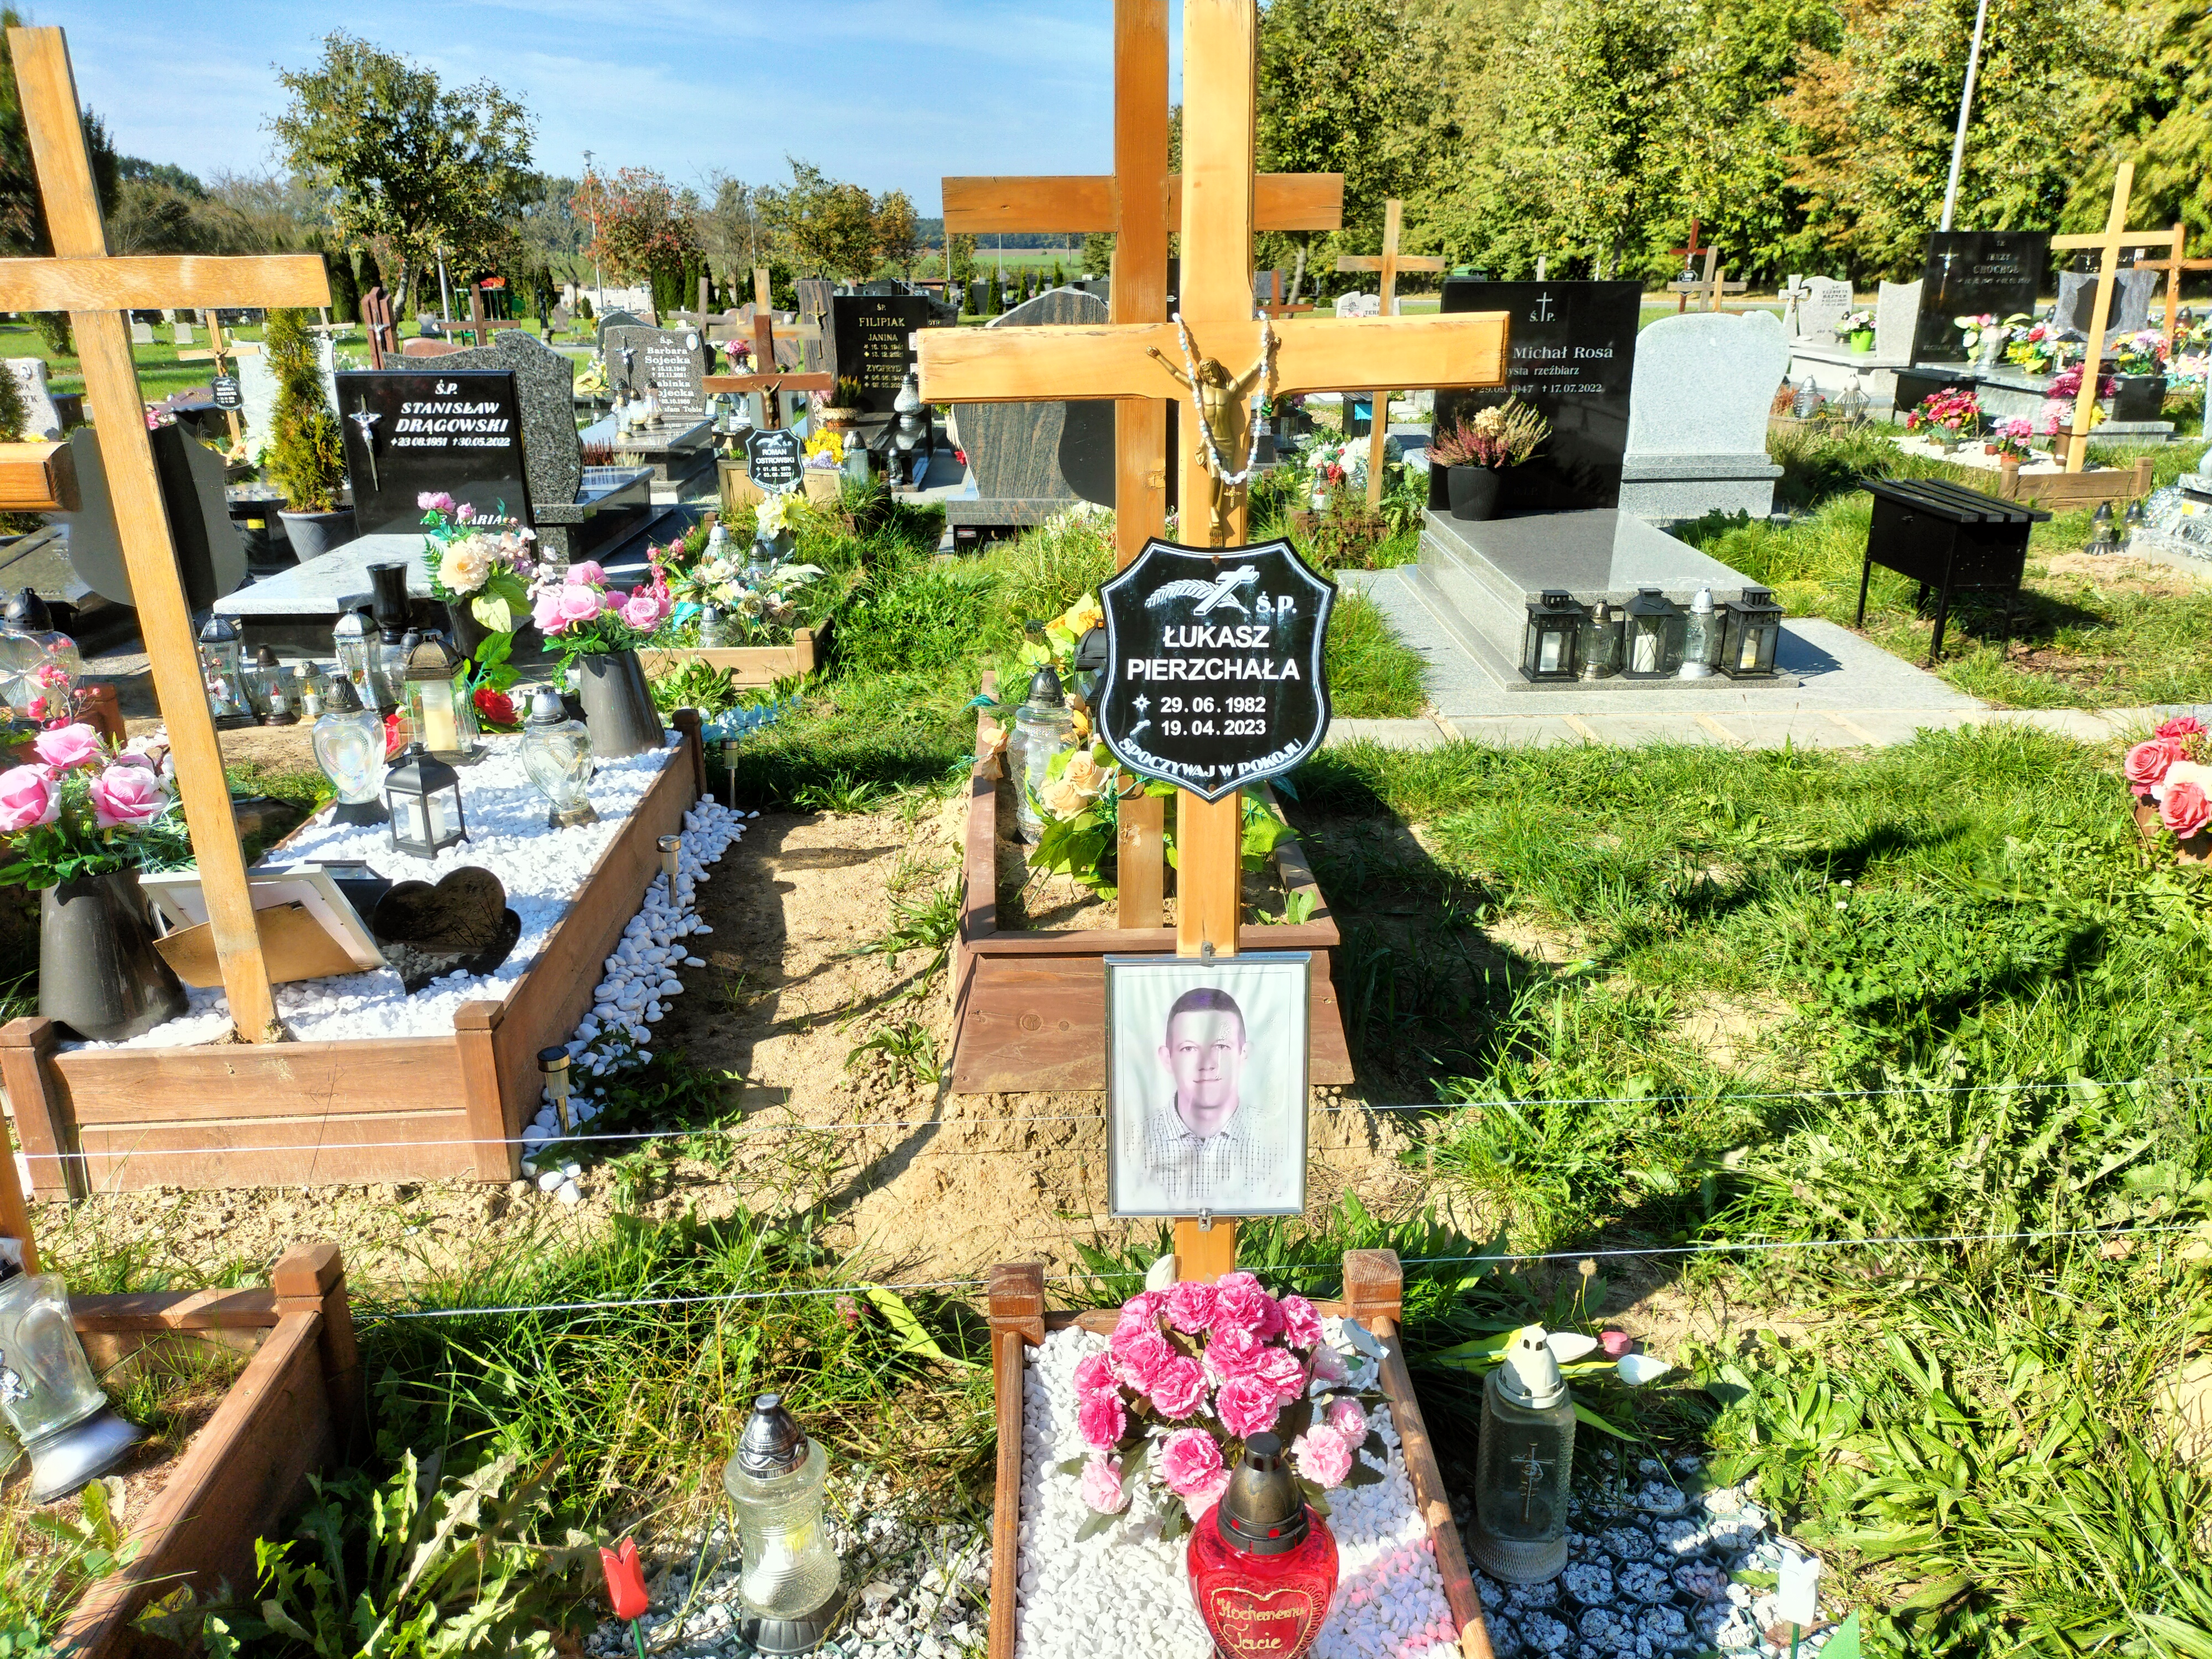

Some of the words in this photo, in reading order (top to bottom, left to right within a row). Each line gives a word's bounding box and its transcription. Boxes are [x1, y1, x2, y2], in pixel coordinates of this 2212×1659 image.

[859, 317, 905, 327] FILIPIAK
[1512, 346, 1568, 359] Michał
[1573, 347, 1614, 358] Rosa
[644, 356, 691, 365] Sojecka
[1534, 365, 1579, 375] rzeźbiarz
[658, 389, 694, 398] ojecka
[1550, 383, 1602, 393] 17.07.2022
[401, 402, 500, 414] STANISŁAW
[395, 419, 509, 435] DRĄGOWSKI
[1256, 591, 1297, 613] Ś.P.
[1162, 625, 1270, 648] ŁUKASZ
[1127, 658, 1301, 680] PIERZCHAŁA
[1118, 738, 1215, 777] SPOCZYWAJ
[1218, 764, 1234, 776] W
[1238, 738, 1302, 775] POKOJU
